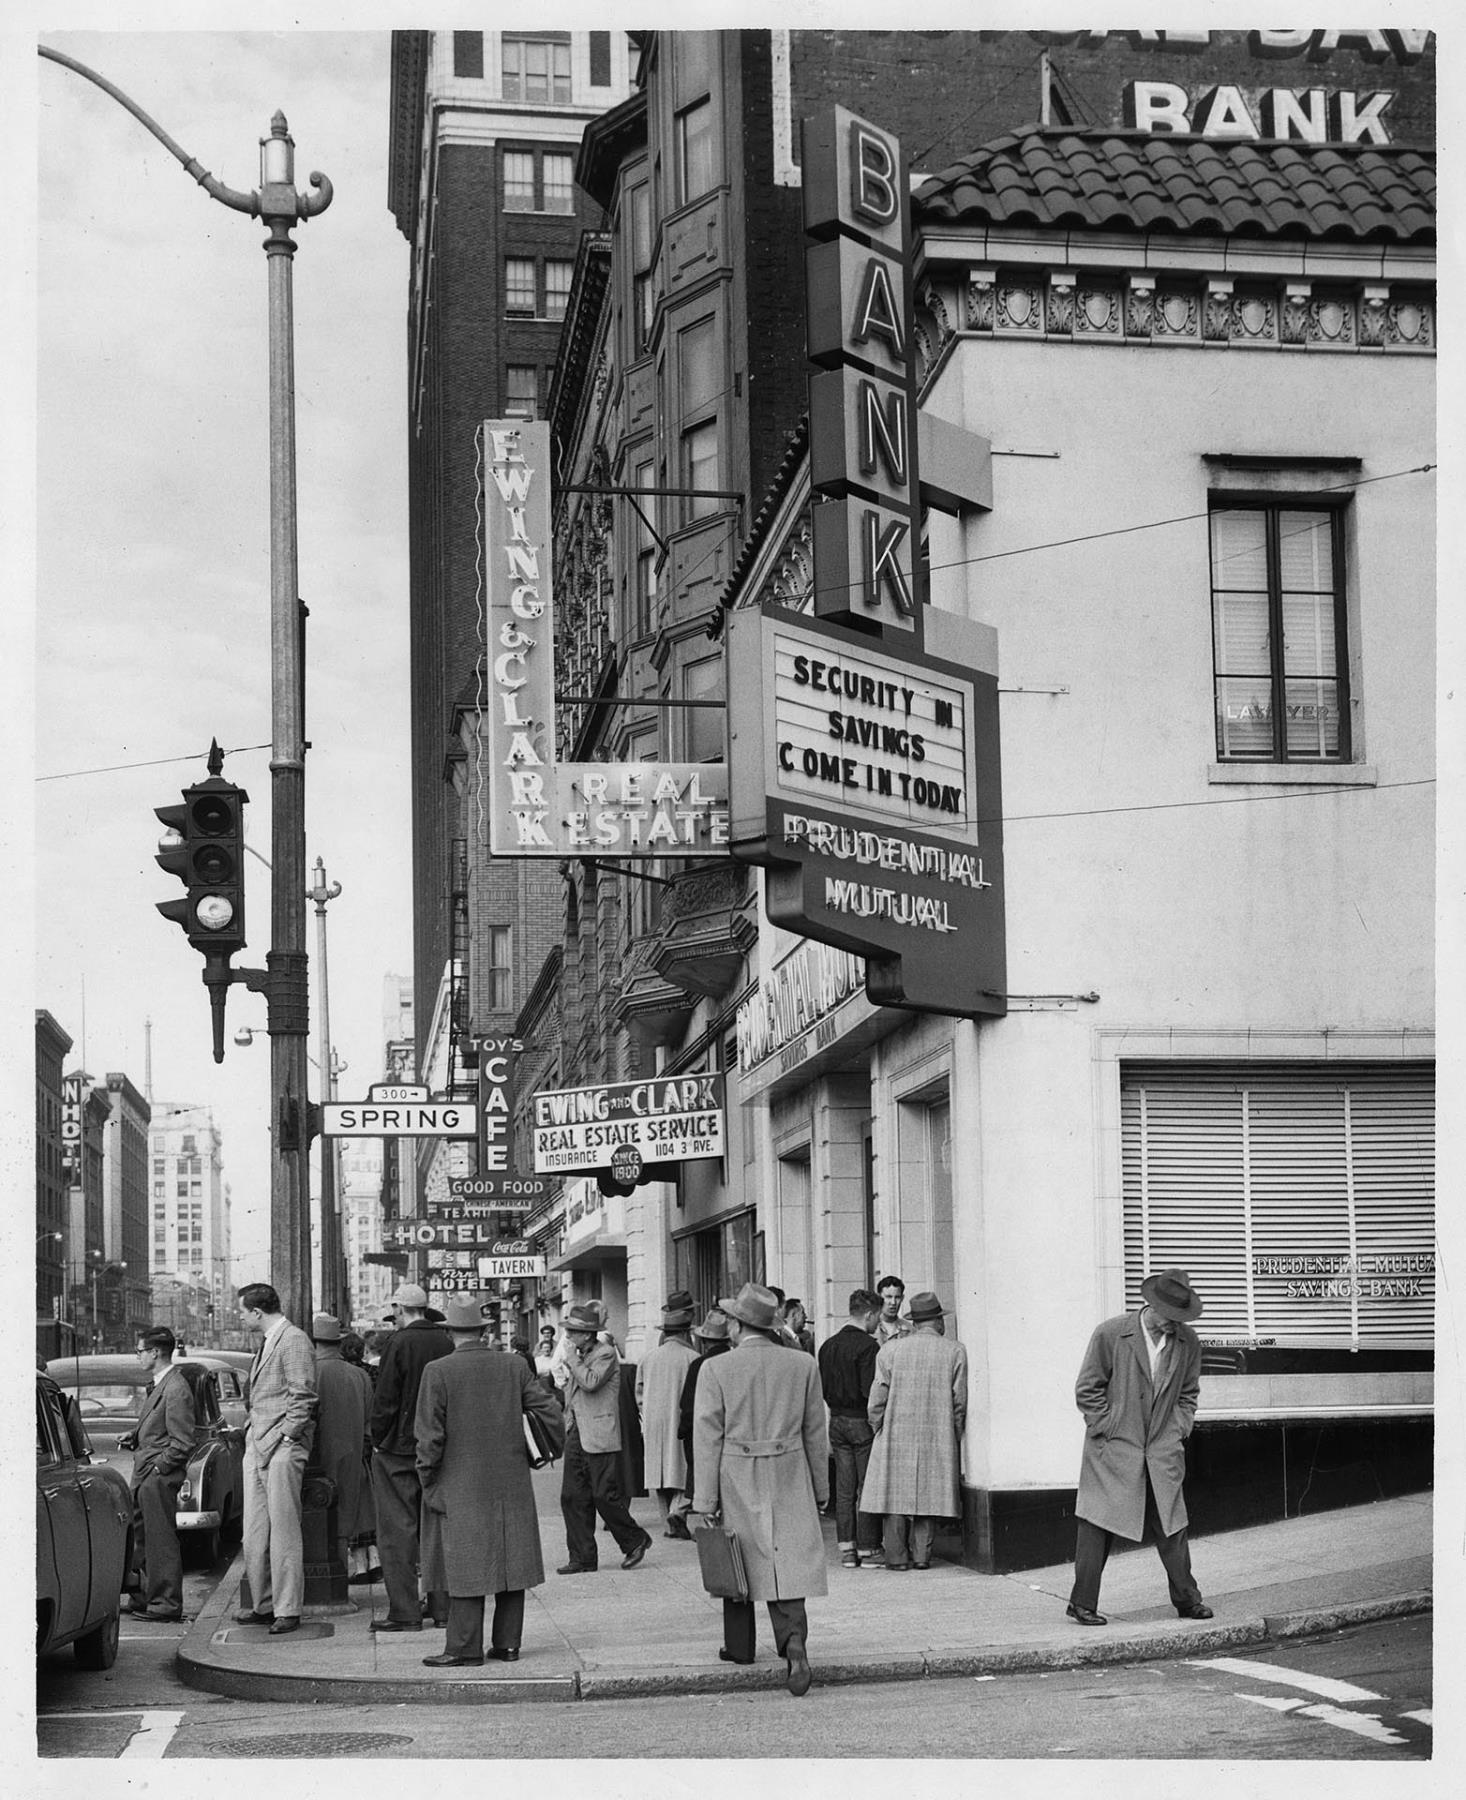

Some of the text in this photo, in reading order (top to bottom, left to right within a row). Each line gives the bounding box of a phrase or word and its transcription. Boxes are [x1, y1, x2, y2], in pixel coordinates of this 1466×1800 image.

[1124, 80, 1395, 145] BANK
[851, 120, 913, 626] BANK
[489, 430, 553, 845] EWING & CLARK
[794, 656, 953, 728] SECURITY IN
[1227, 704, 1329, 720] LAWYER
[829, 710, 926, 762] SAVINGS
[583, 771, 716, 806] REAL
[780, 742, 962, 815] COME IN TODAY
[568, 811, 729, 846] ESTATE
[783, 812, 993, 890] PRUDENTIAL
[825, 876, 958, 933] MUTUAL
[470, 1037, 525, 1052] TOY'S
[381, 1089, 408, 1099] 300
[535, 1090, 609, 1126] EWING
[631, 1078, 718, 1117] CLARK
[339, 1110, 460, 1128] SPRING
[485, 1056, 509, 1171] CAFE
[538, 1115, 719, 1152] REAL ESTATE SERVICE
[545, 1150, 598, 1167] INSURANCE
[614, 1151, 640, 1166] SINCE
[613, 1165, 641, 1180] 1900
[452, 1180, 544, 1195] GOOD FOOD
[397, 1224, 491, 1246] HOTEL
[441, 1269, 475, 1279] Fern
[491, 1259, 535, 1275] TAVERN
[1256, 1256, 1368, 1274] PRUDENTIAL
[429, 1278, 490, 1290] HOTEL
[1287, 1278, 1422, 1298] SAVINGS BANK
